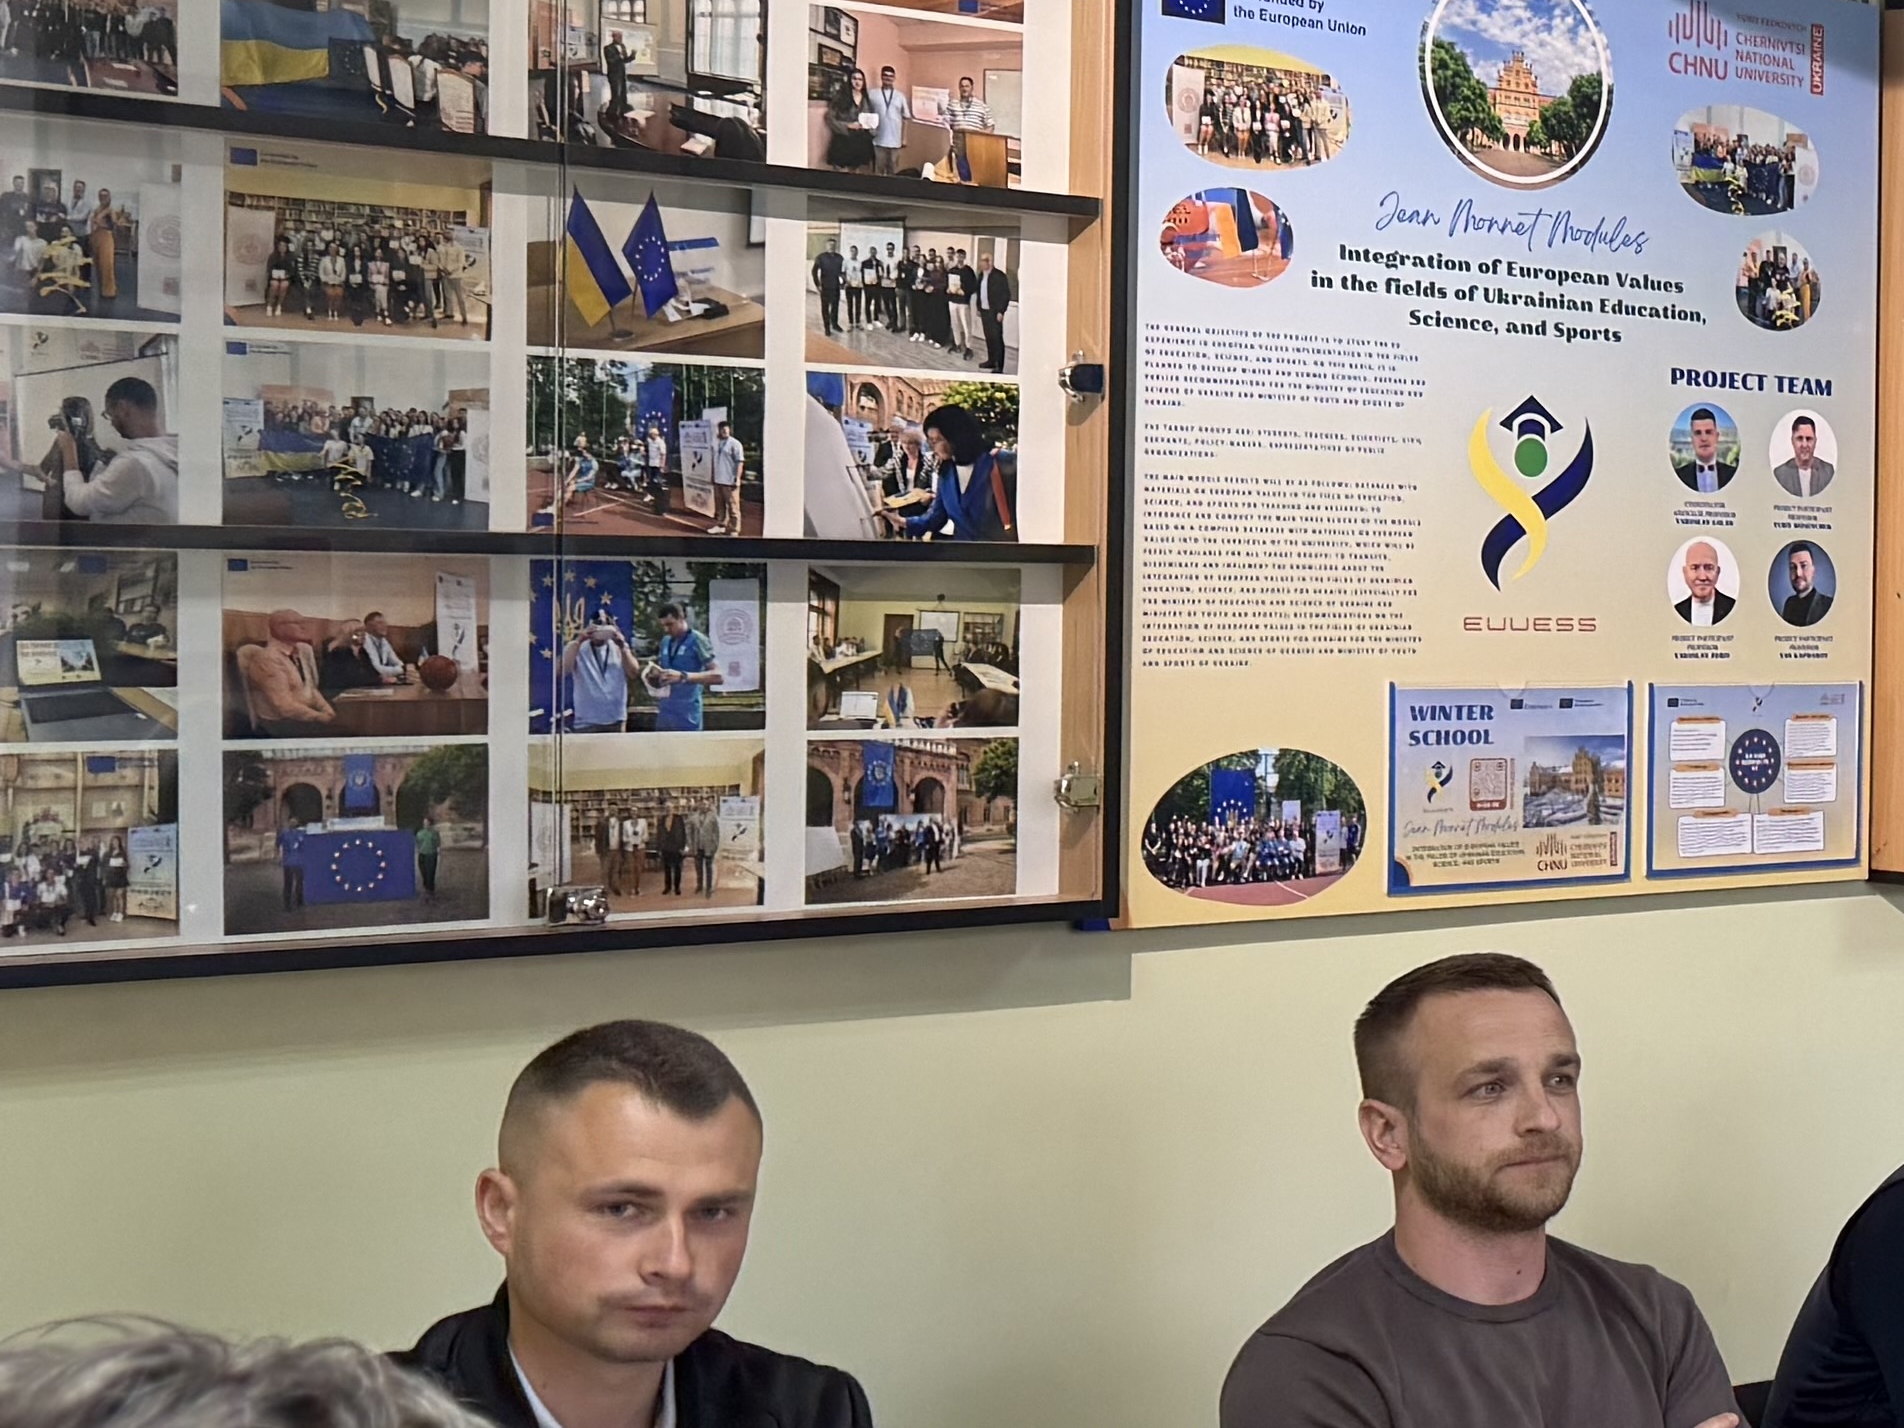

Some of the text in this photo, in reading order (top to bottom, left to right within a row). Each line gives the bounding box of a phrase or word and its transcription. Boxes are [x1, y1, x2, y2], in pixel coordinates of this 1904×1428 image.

[1234, 6, 1367, 37] the European Union
[1736, 32, 1805, 55] CHERNIVTSI
[1668, 52, 1728, 80] CHNU
[1735, 49, 1795, 71] NATIONAL
[1812, 26, 1823, 93] UKRAINE
[1735, 66, 1804, 88] UNIVERSITY
[1375, 191, 1650, 255] Jean Monnet Modules
[1339, 244, 1685, 294] Integration of European Values
[1310, 270, 1707, 326] in the fields of Ukrainian Education,
[1408, 309, 1622, 344] Science, and Sports
[1670, 367, 1832, 397] PROJECT TEAM
[1463, 616, 1597, 632] EUUESS
[1410, 704, 1494, 722] WINTER
[1408, 728, 1494, 747] SCHOOL
